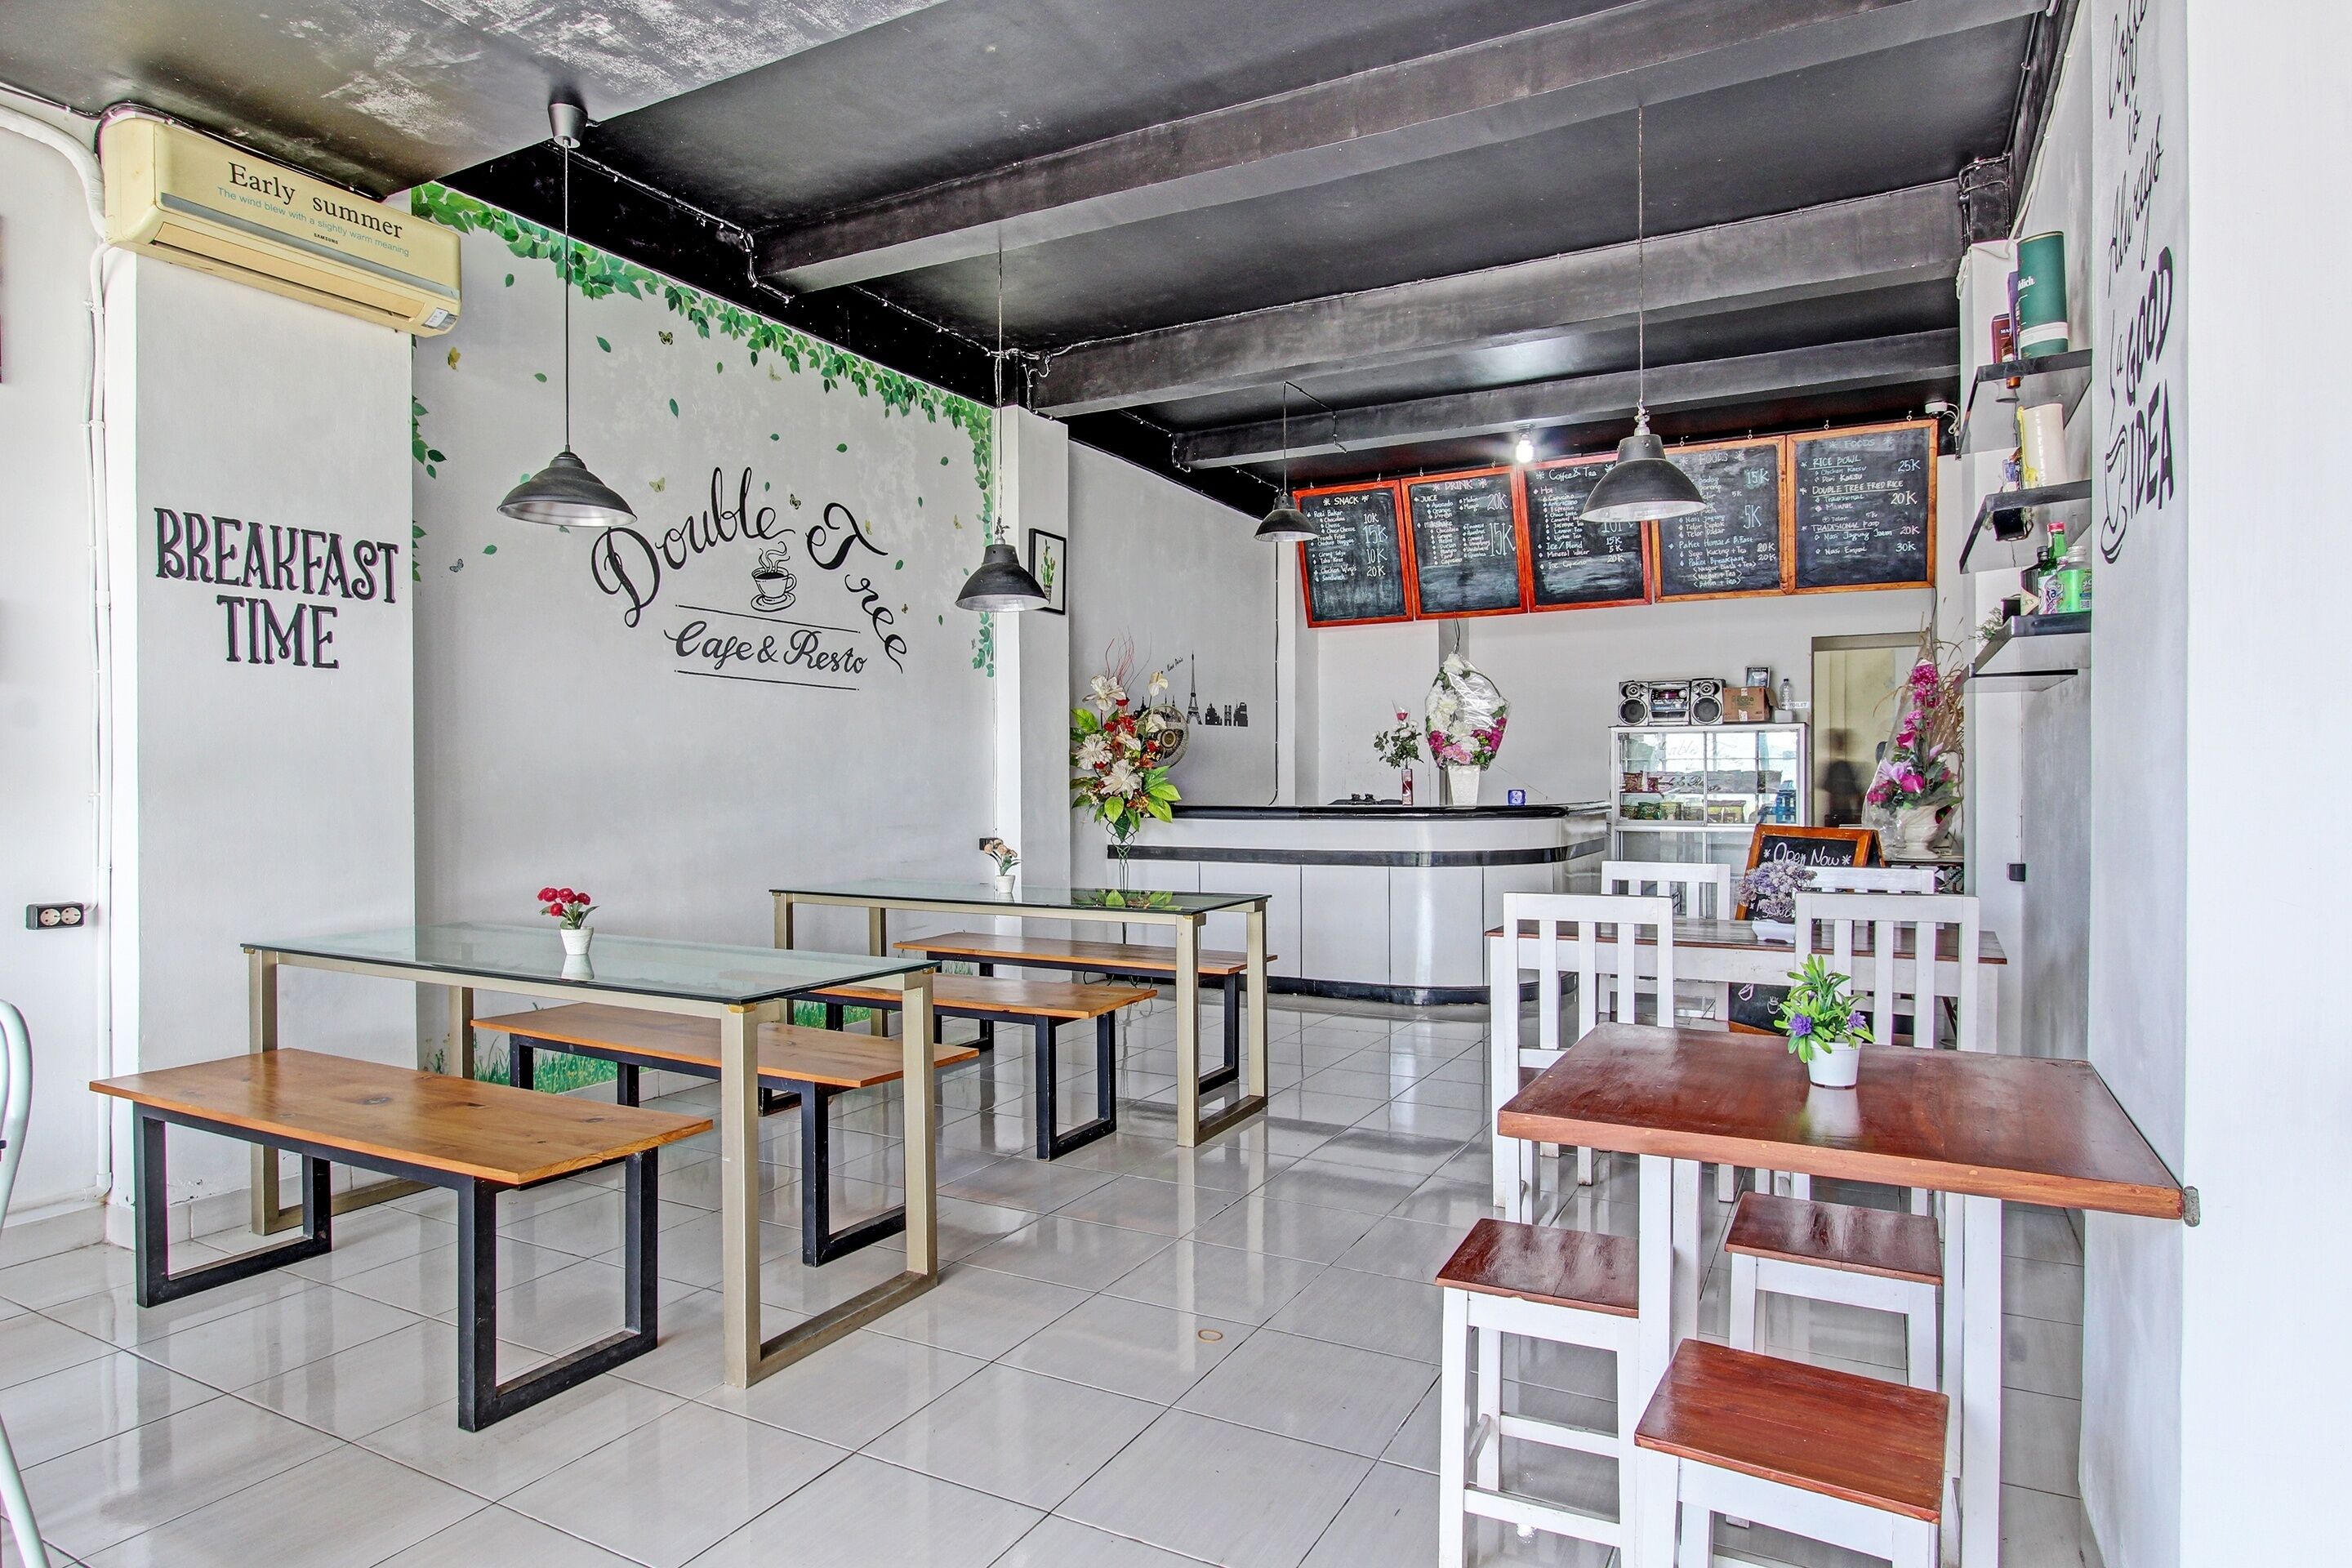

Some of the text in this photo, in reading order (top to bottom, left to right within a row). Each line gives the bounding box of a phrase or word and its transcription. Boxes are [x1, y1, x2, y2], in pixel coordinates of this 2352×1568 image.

[229, 161, 403, 239] Early summer
[217, 186, 410, 258] The wind blew with a slightly warm meaning
[314, 233, 340, 245] SAMSUNG
[2126, 246, 2174, 408] GOOD
[1844, 439, 1876, 449] FOODS
[2129, 377, 2174, 520] IDEA
[1813, 455, 1861, 467] RICE BOWL
[1897, 458, 1921, 472] 25K
[1584, 466, 1597, 477] Tea
[1746, 468, 1771, 484] 15K
[1445, 479, 1474, 490] DRINK
[1812, 485, 1842, 495] DOUBLE
[1845, 483, 1865, 492] TREE
[1886, 479, 1904, 488] RICE
[1334, 497, 1360, 506] SNACK
[1420, 494, 1438, 503] JUICE
[1486, 492, 1509, 510] 20K
[1890, 490, 1918, 506] 20K
[1363, 512, 1379, 524] 10K
[1743, 504, 1762, 529] 5K
[1362, 524, 1388, 544] 15K
[1811, 523, 1860, 532] TRADISIONAL
[1900, 525, 1921, 535] 20K
[1490, 522, 1516, 556] 15K
[1606, 537, 1623, 546] 15K
[1757, 542, 1776, 552] 20K
[1895, 541, 1917, 553] 30K
[154, 507, 400, 604] BREAKFAST
[1366, 548, 1388, 564] 10K
[1606, 555, 1624, 564] 20K
[1757, 553, 1777, 561] 20K
[591, 466, 908, 675] Double Tree
[1366, 565, 1387, 577] 20K
[216, 594, 341, 670] TIME
[664, 620, 869, 675] Cafe & Resto
[1811, 846, 1840, 866] Now
